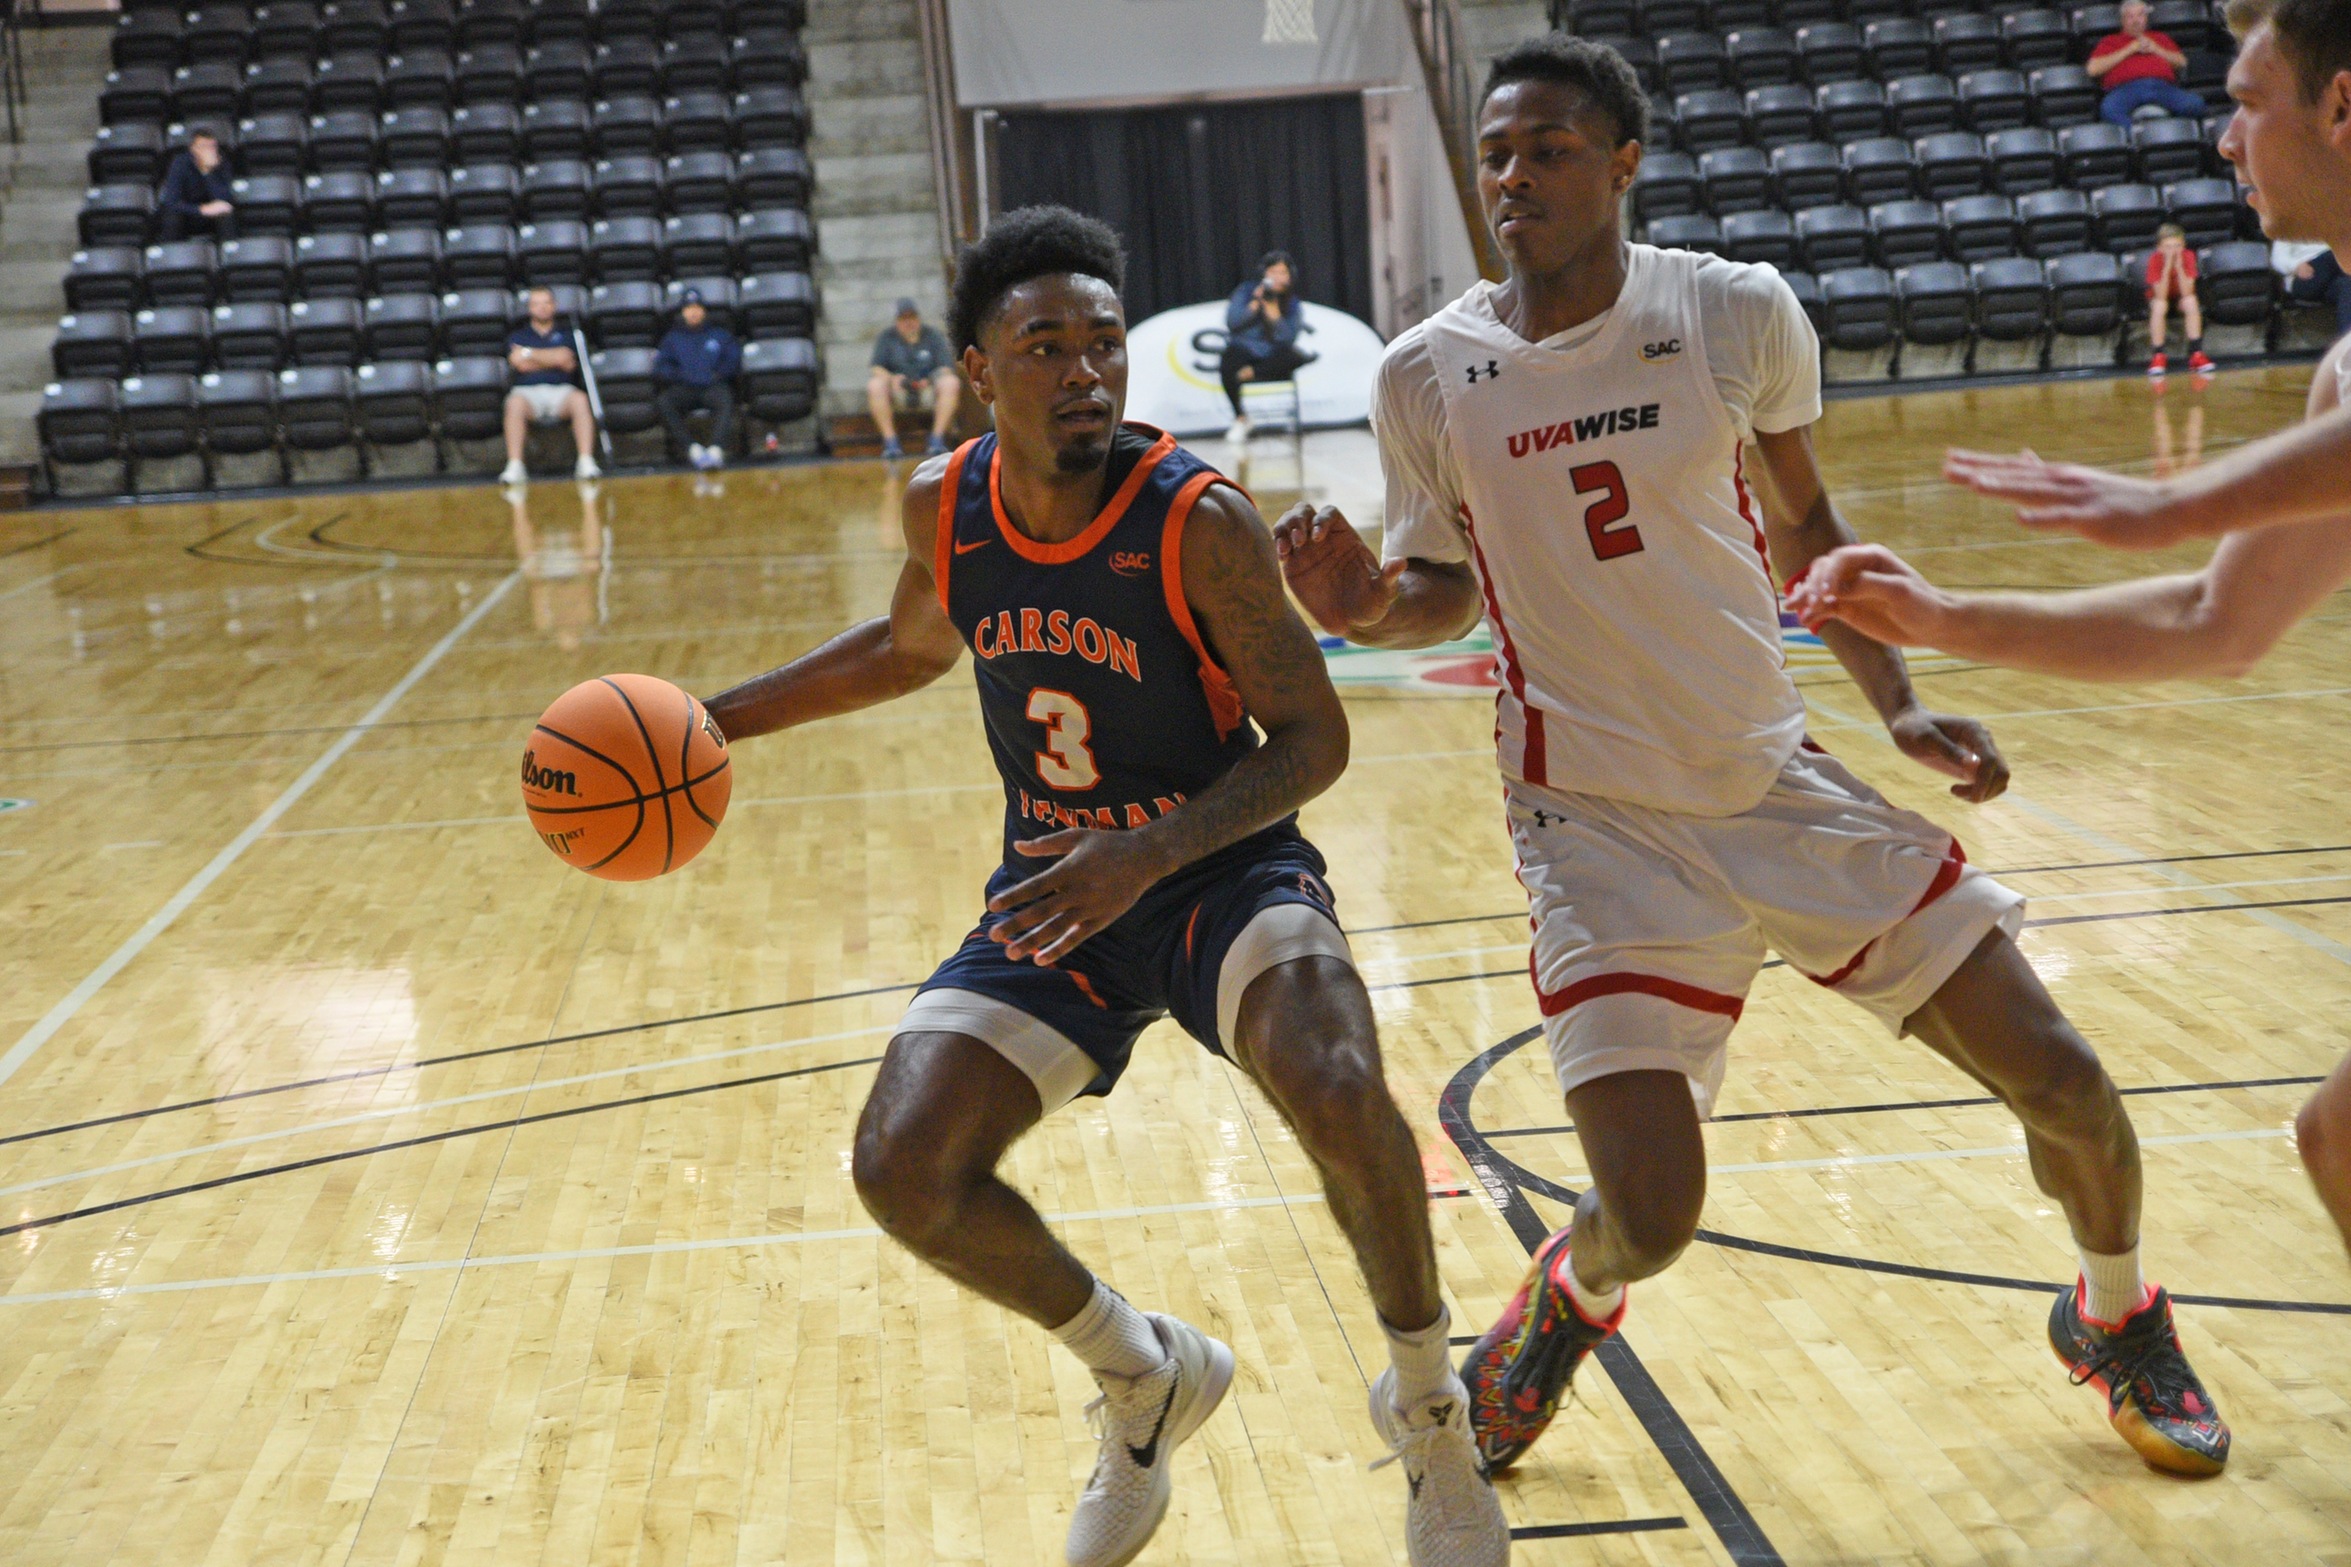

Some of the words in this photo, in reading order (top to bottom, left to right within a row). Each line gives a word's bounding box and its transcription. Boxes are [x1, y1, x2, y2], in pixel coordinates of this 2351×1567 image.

[1643, 339, 1681, 359] SAC
[1569, 460, 1645, 561] 2
[1113, 551, 1150, 570] SAC
[974, 606, 1142, 683] CARSON
[1025, 686, 1102, 791] 3
